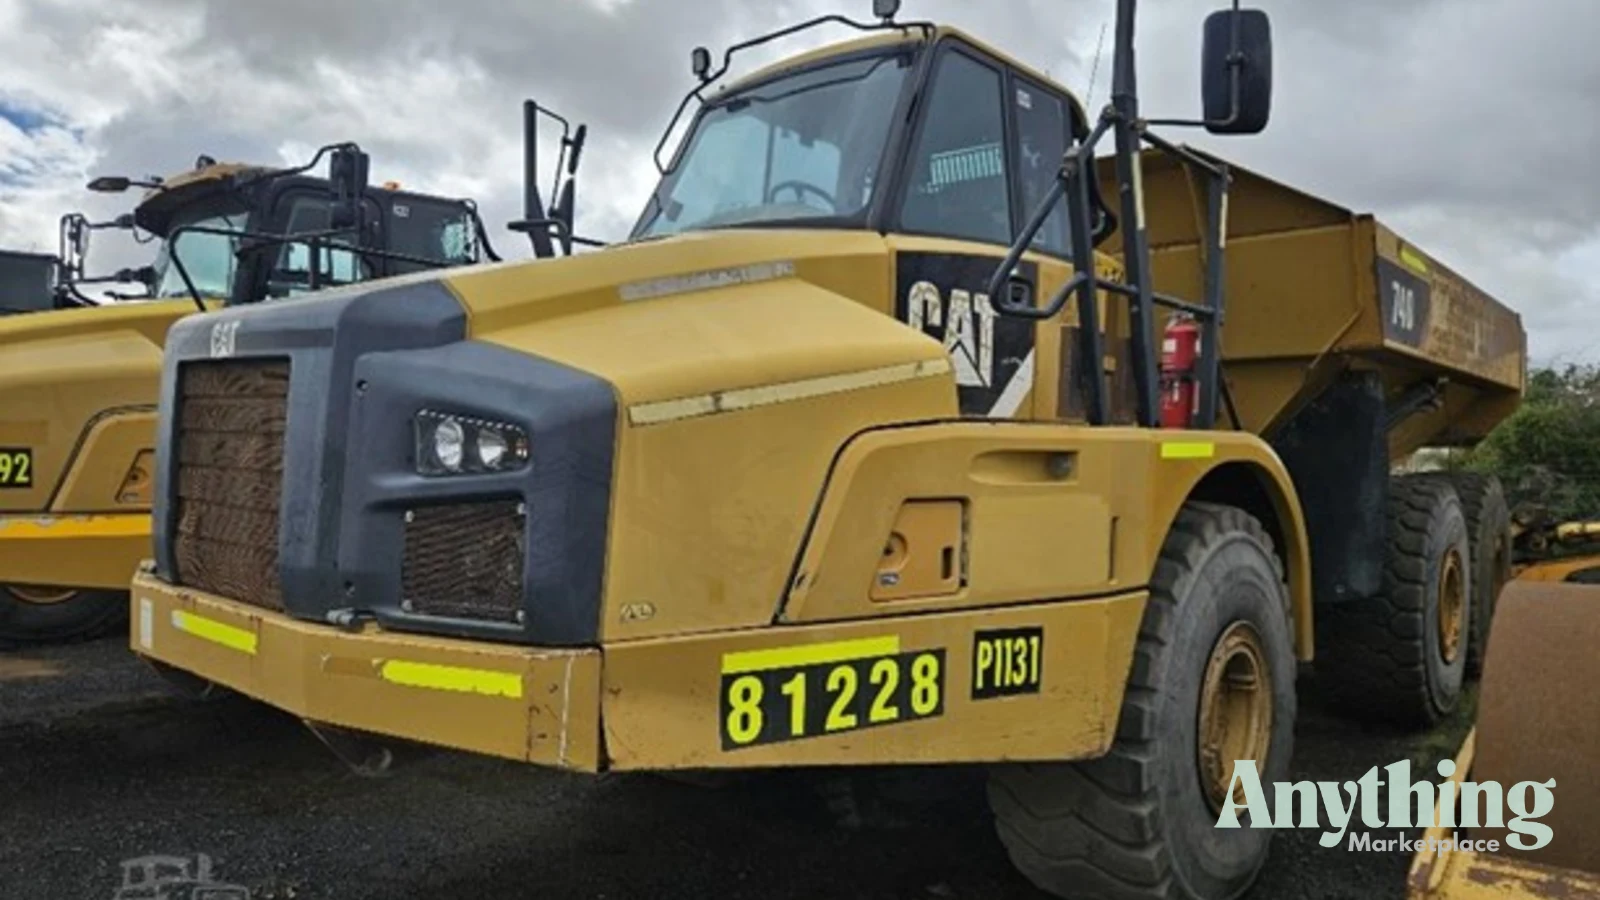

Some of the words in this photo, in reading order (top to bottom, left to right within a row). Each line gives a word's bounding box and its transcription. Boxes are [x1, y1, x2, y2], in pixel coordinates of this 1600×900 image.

[0, 452, 29, 482] 92
[975, 634, 1041, 690] P1131
[726, 653, 940, 744] 81228
